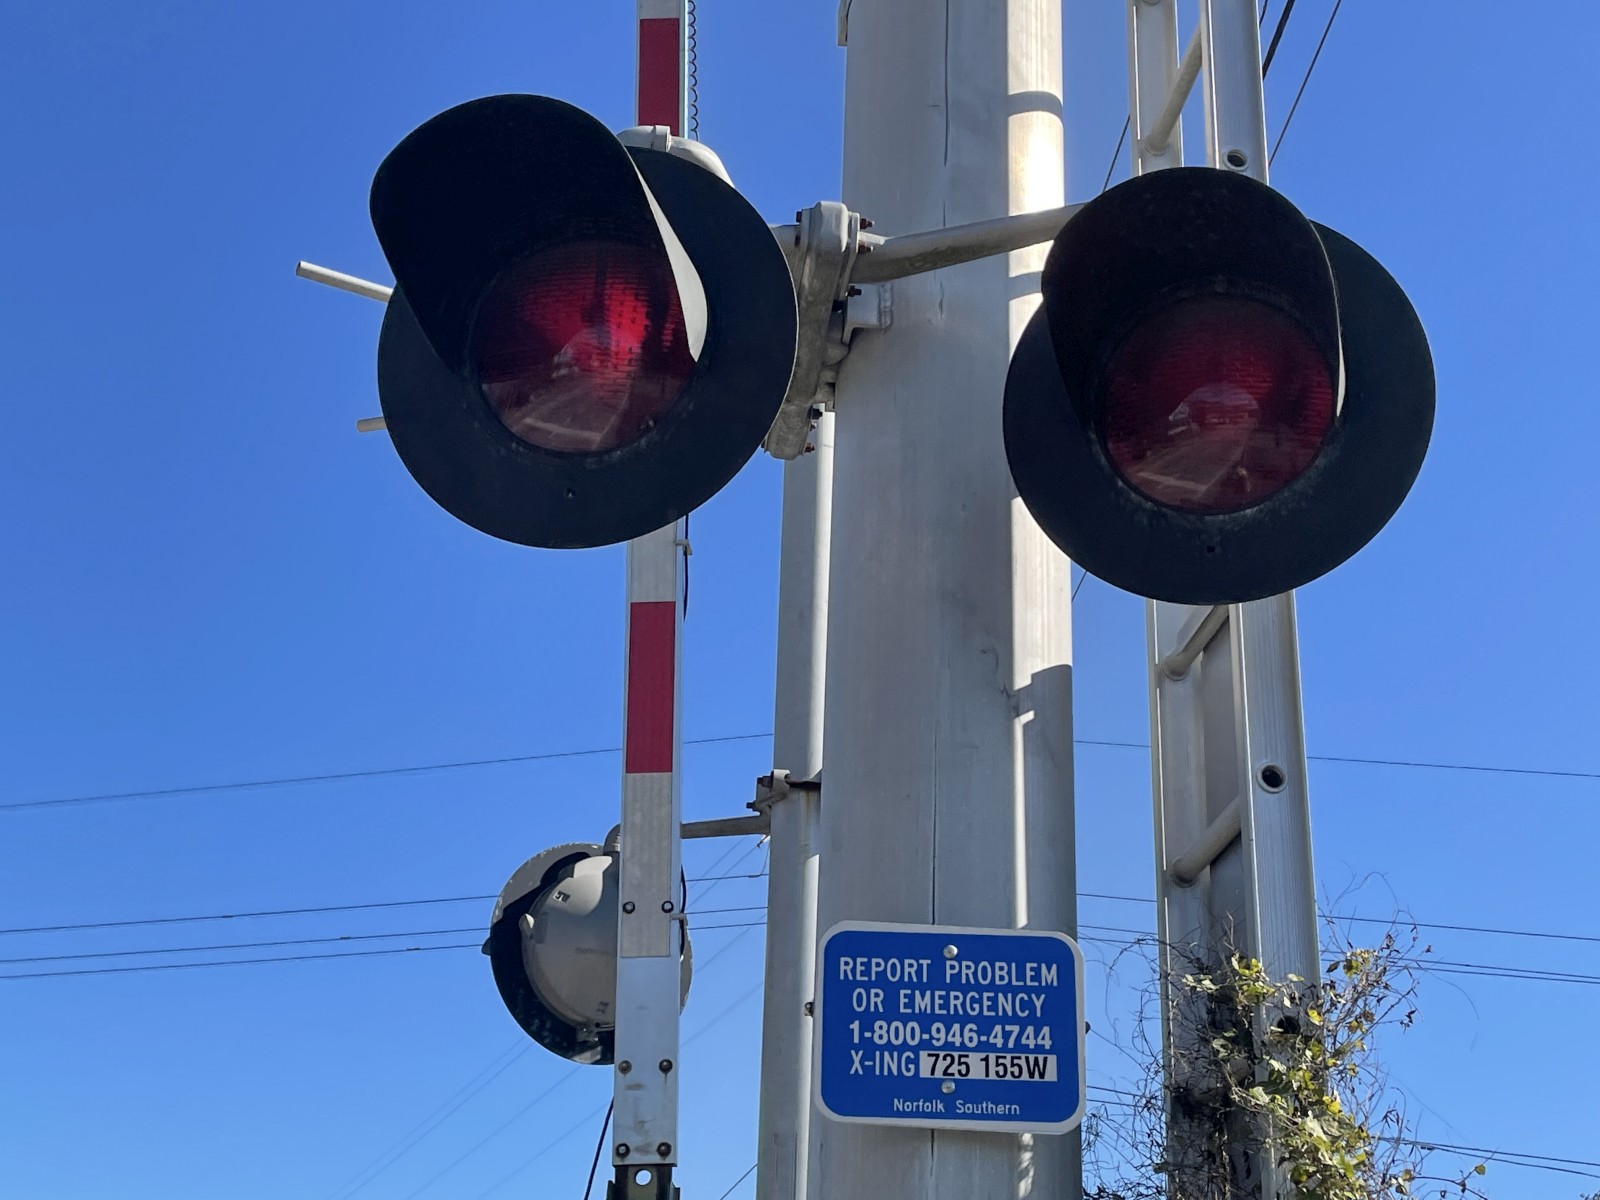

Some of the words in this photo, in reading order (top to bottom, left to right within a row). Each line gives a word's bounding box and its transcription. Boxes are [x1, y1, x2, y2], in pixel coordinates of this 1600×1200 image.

[839, 957, 931, 983] REPORT
[945, 961, 1058, 987] PROBLEM
[852, 988, 884, 1013] OR
[899, 990, 1046, 1018] EMERGENCY
[849, 1020, 1052, 1050] 1-800-946-4744
[849, 1050, 915, 1077] X-ING
[927, 1053, 971, 1078] 725
[980, 1054, 1048, 1080] 155W
[893, 1098, 945, 1114] Norfolk
[956, 1100, 1020, 1115] Southern
